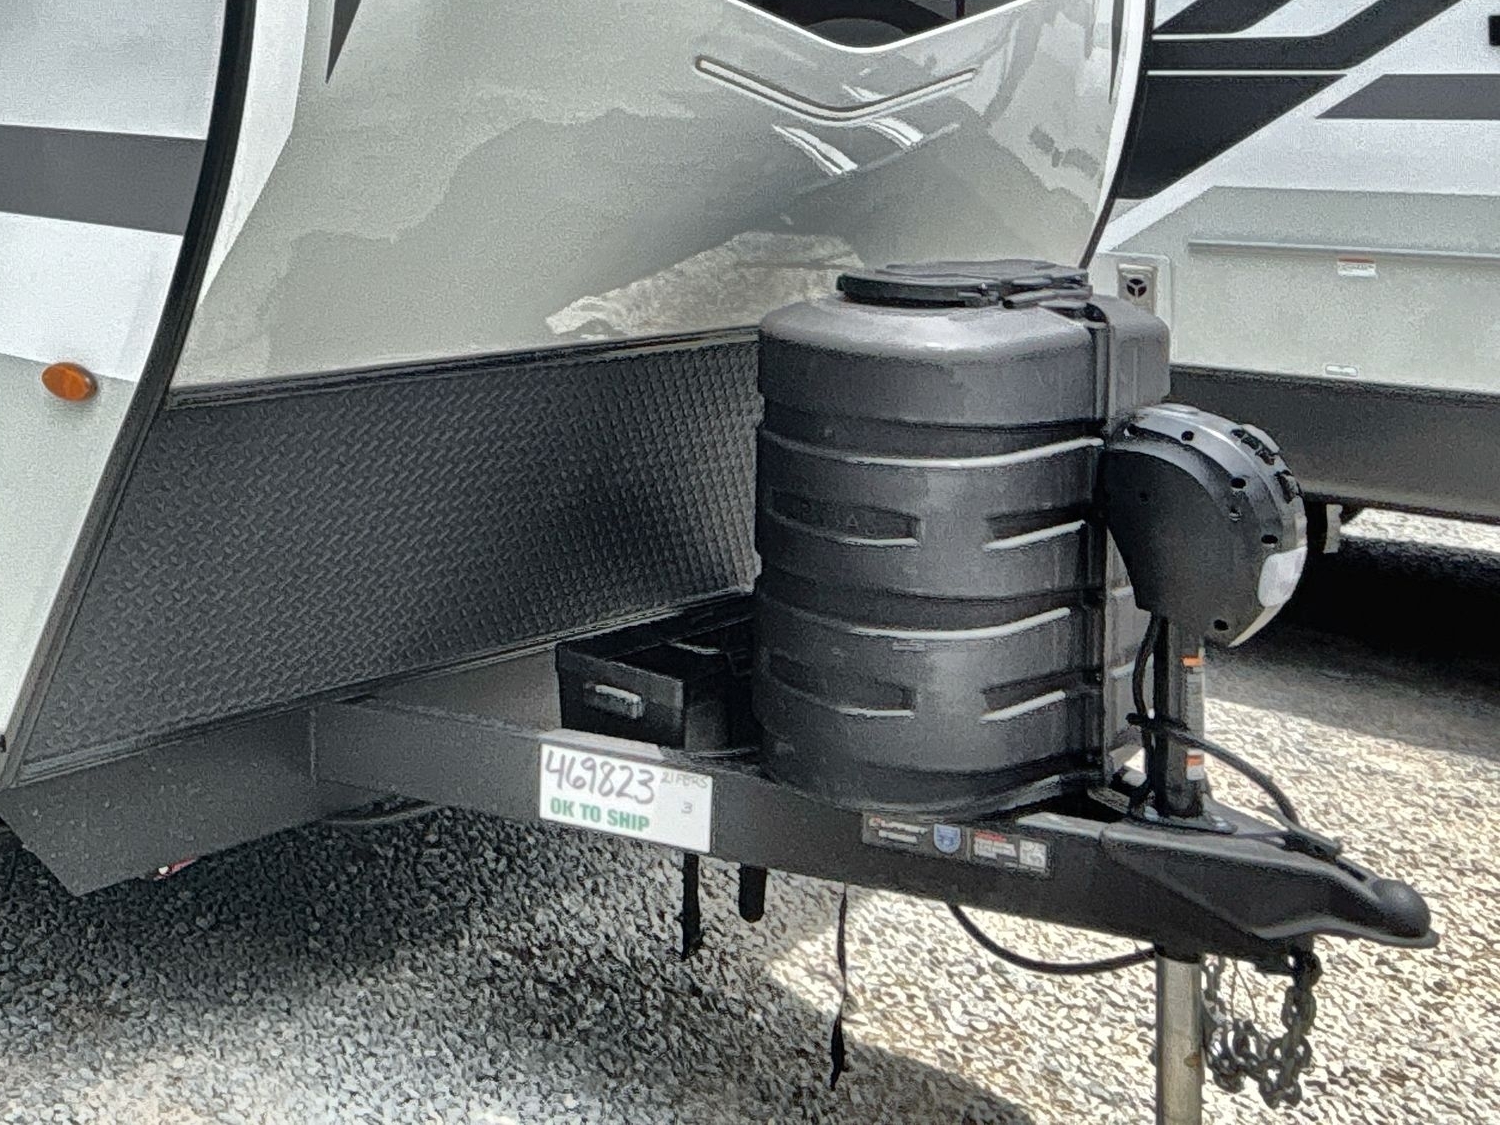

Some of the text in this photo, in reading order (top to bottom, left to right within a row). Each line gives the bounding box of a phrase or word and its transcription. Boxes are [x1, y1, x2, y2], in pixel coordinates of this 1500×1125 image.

[545, 749, 655, 805] 469823
[550, 796, 651, 832] OK TO SHIP
